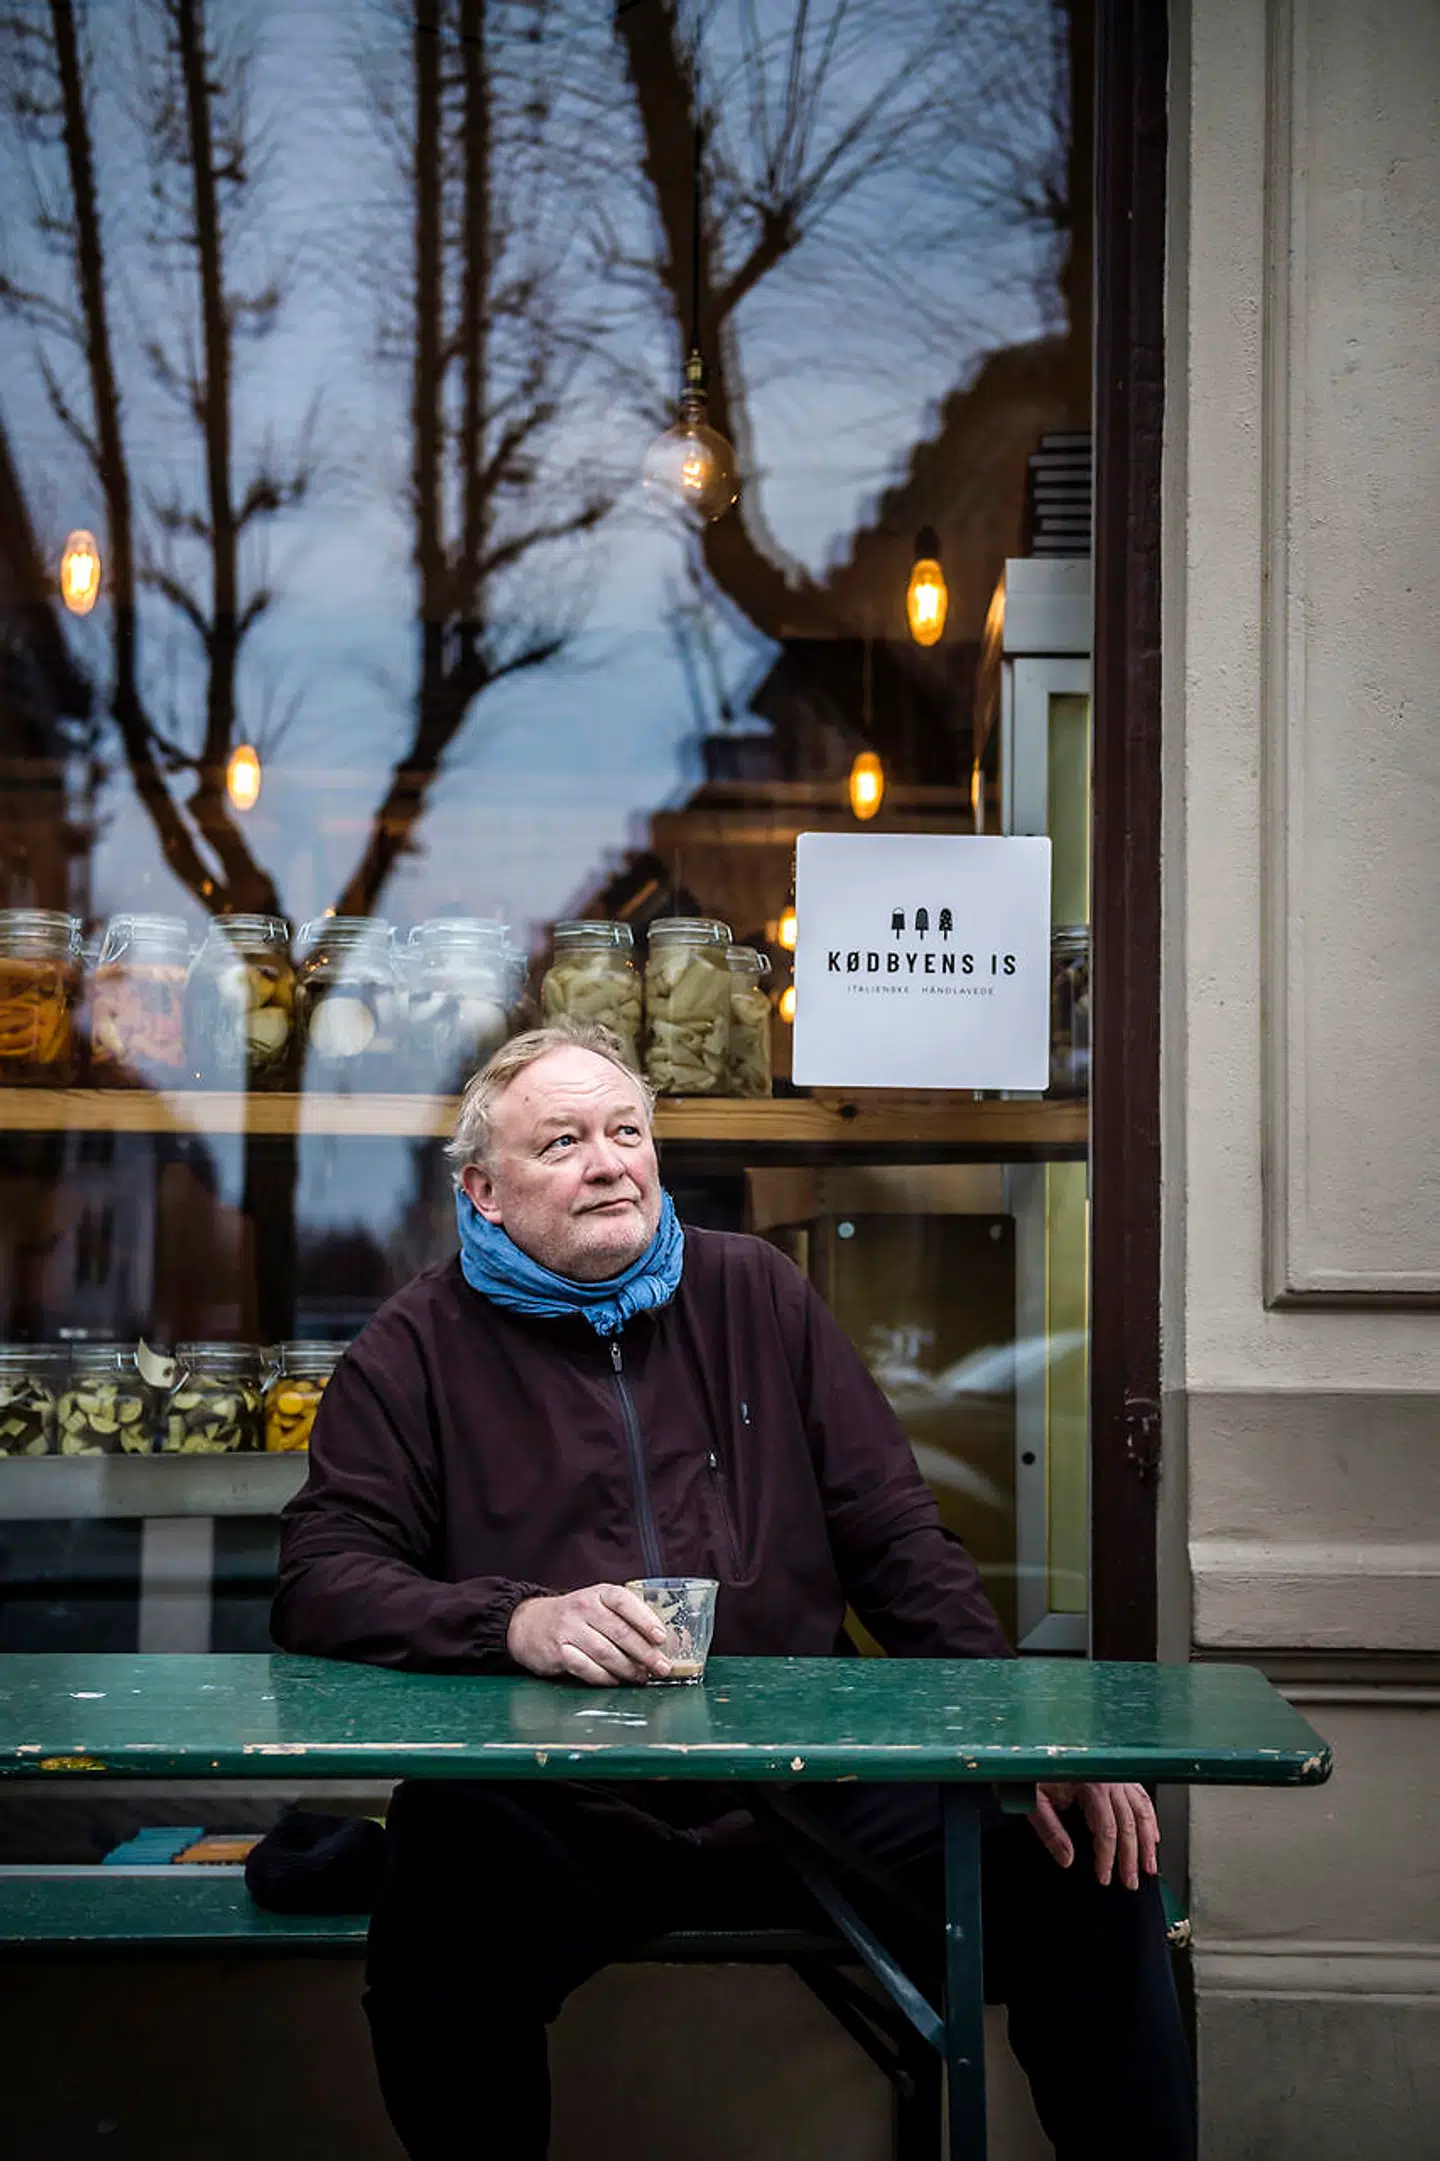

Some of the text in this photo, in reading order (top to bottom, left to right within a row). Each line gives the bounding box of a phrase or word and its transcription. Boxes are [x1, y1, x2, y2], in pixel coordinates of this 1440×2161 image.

[828, 951, 1016, 975] KØDBYENS IS
[847, 985, 909, 994] ITALIENSKE
